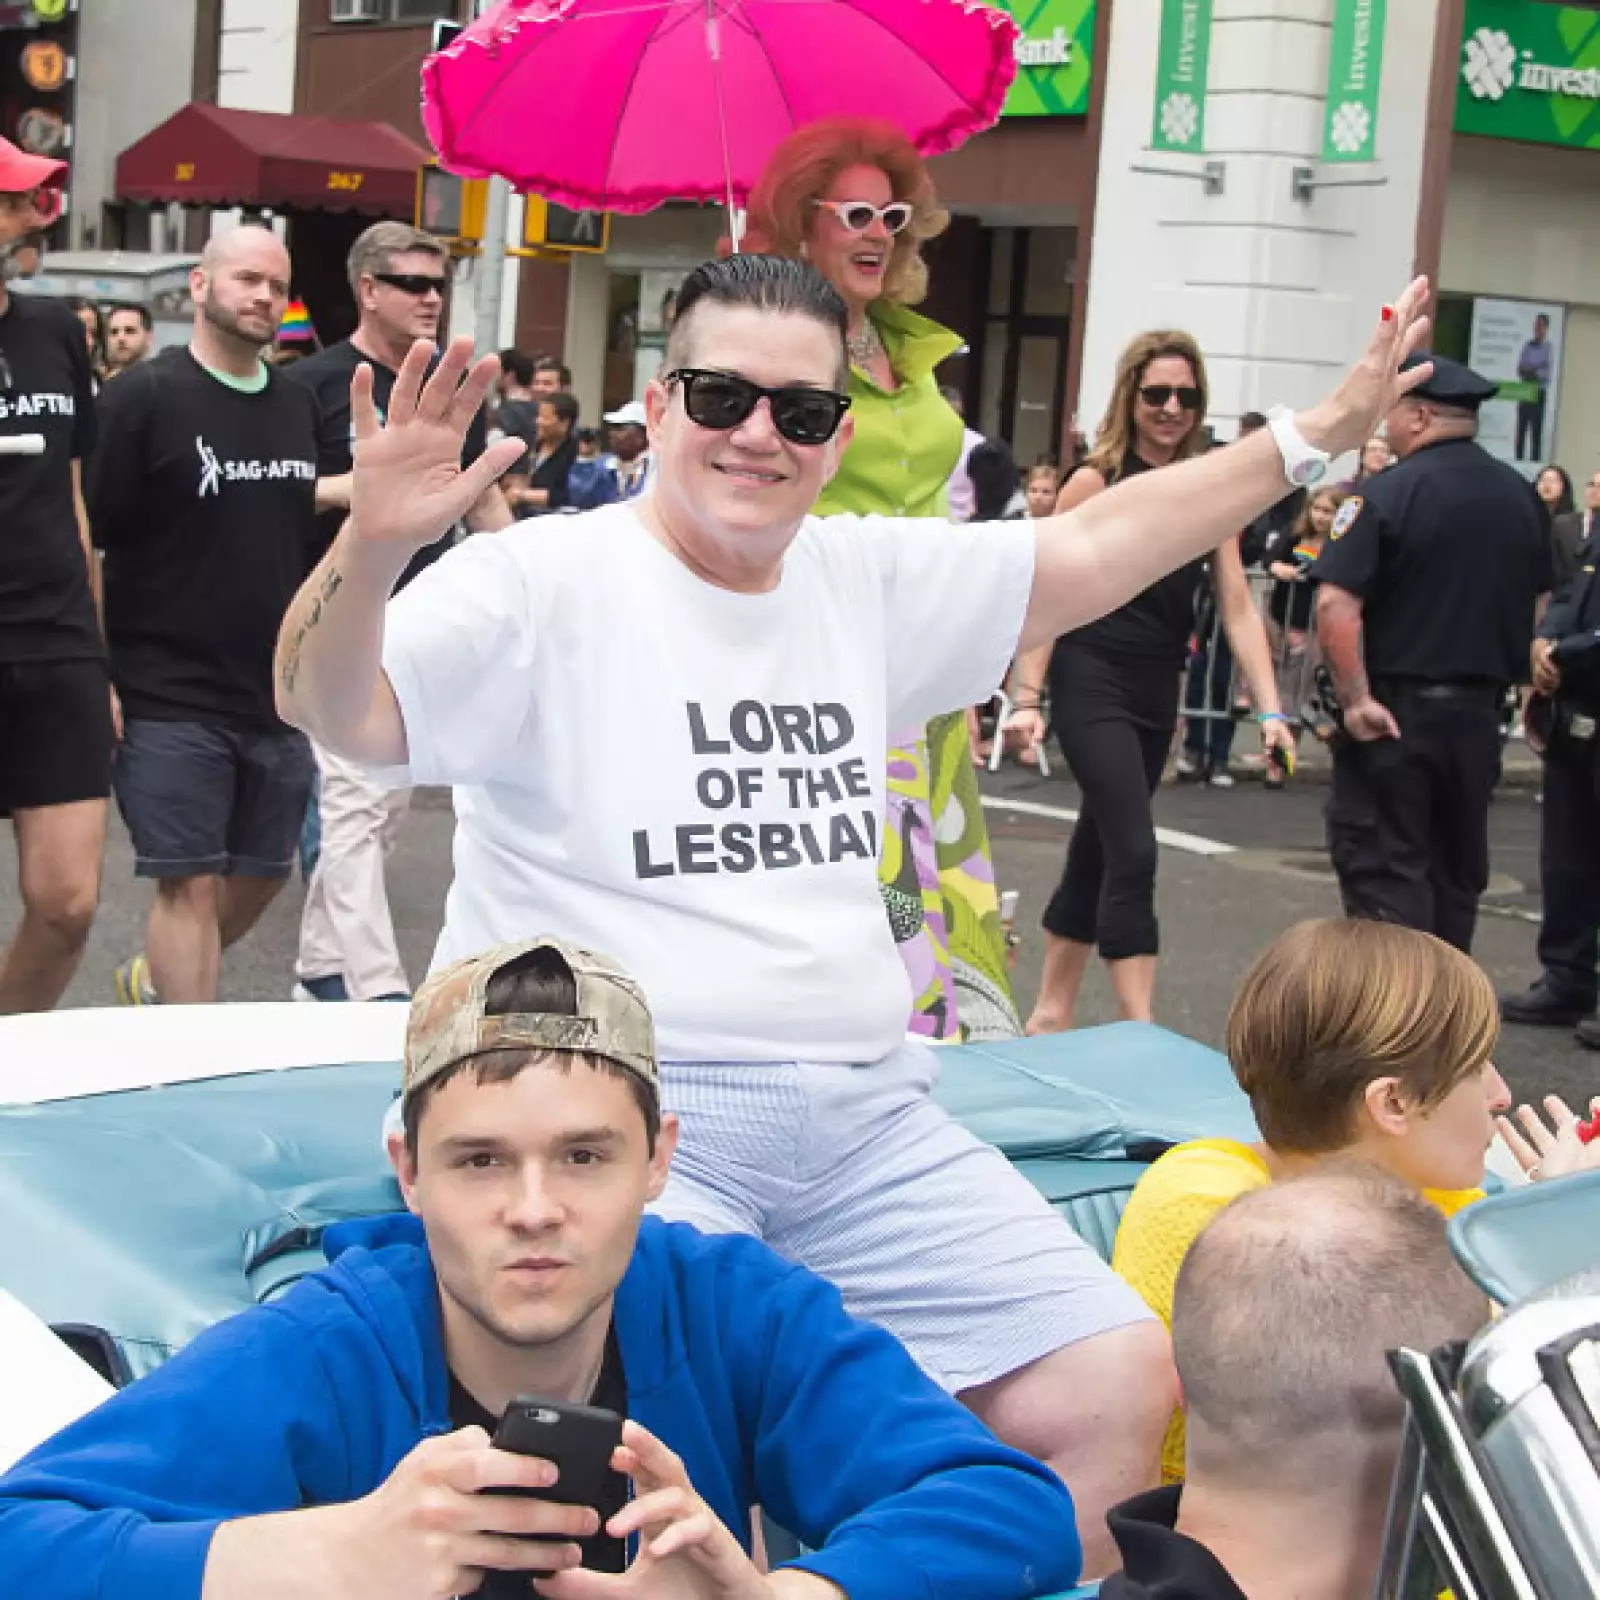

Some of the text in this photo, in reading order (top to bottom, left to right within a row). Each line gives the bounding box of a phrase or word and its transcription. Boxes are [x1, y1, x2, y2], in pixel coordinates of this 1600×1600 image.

[686, 700, 855, 754] LORD
[696, 757, 871, 810] OF THE
